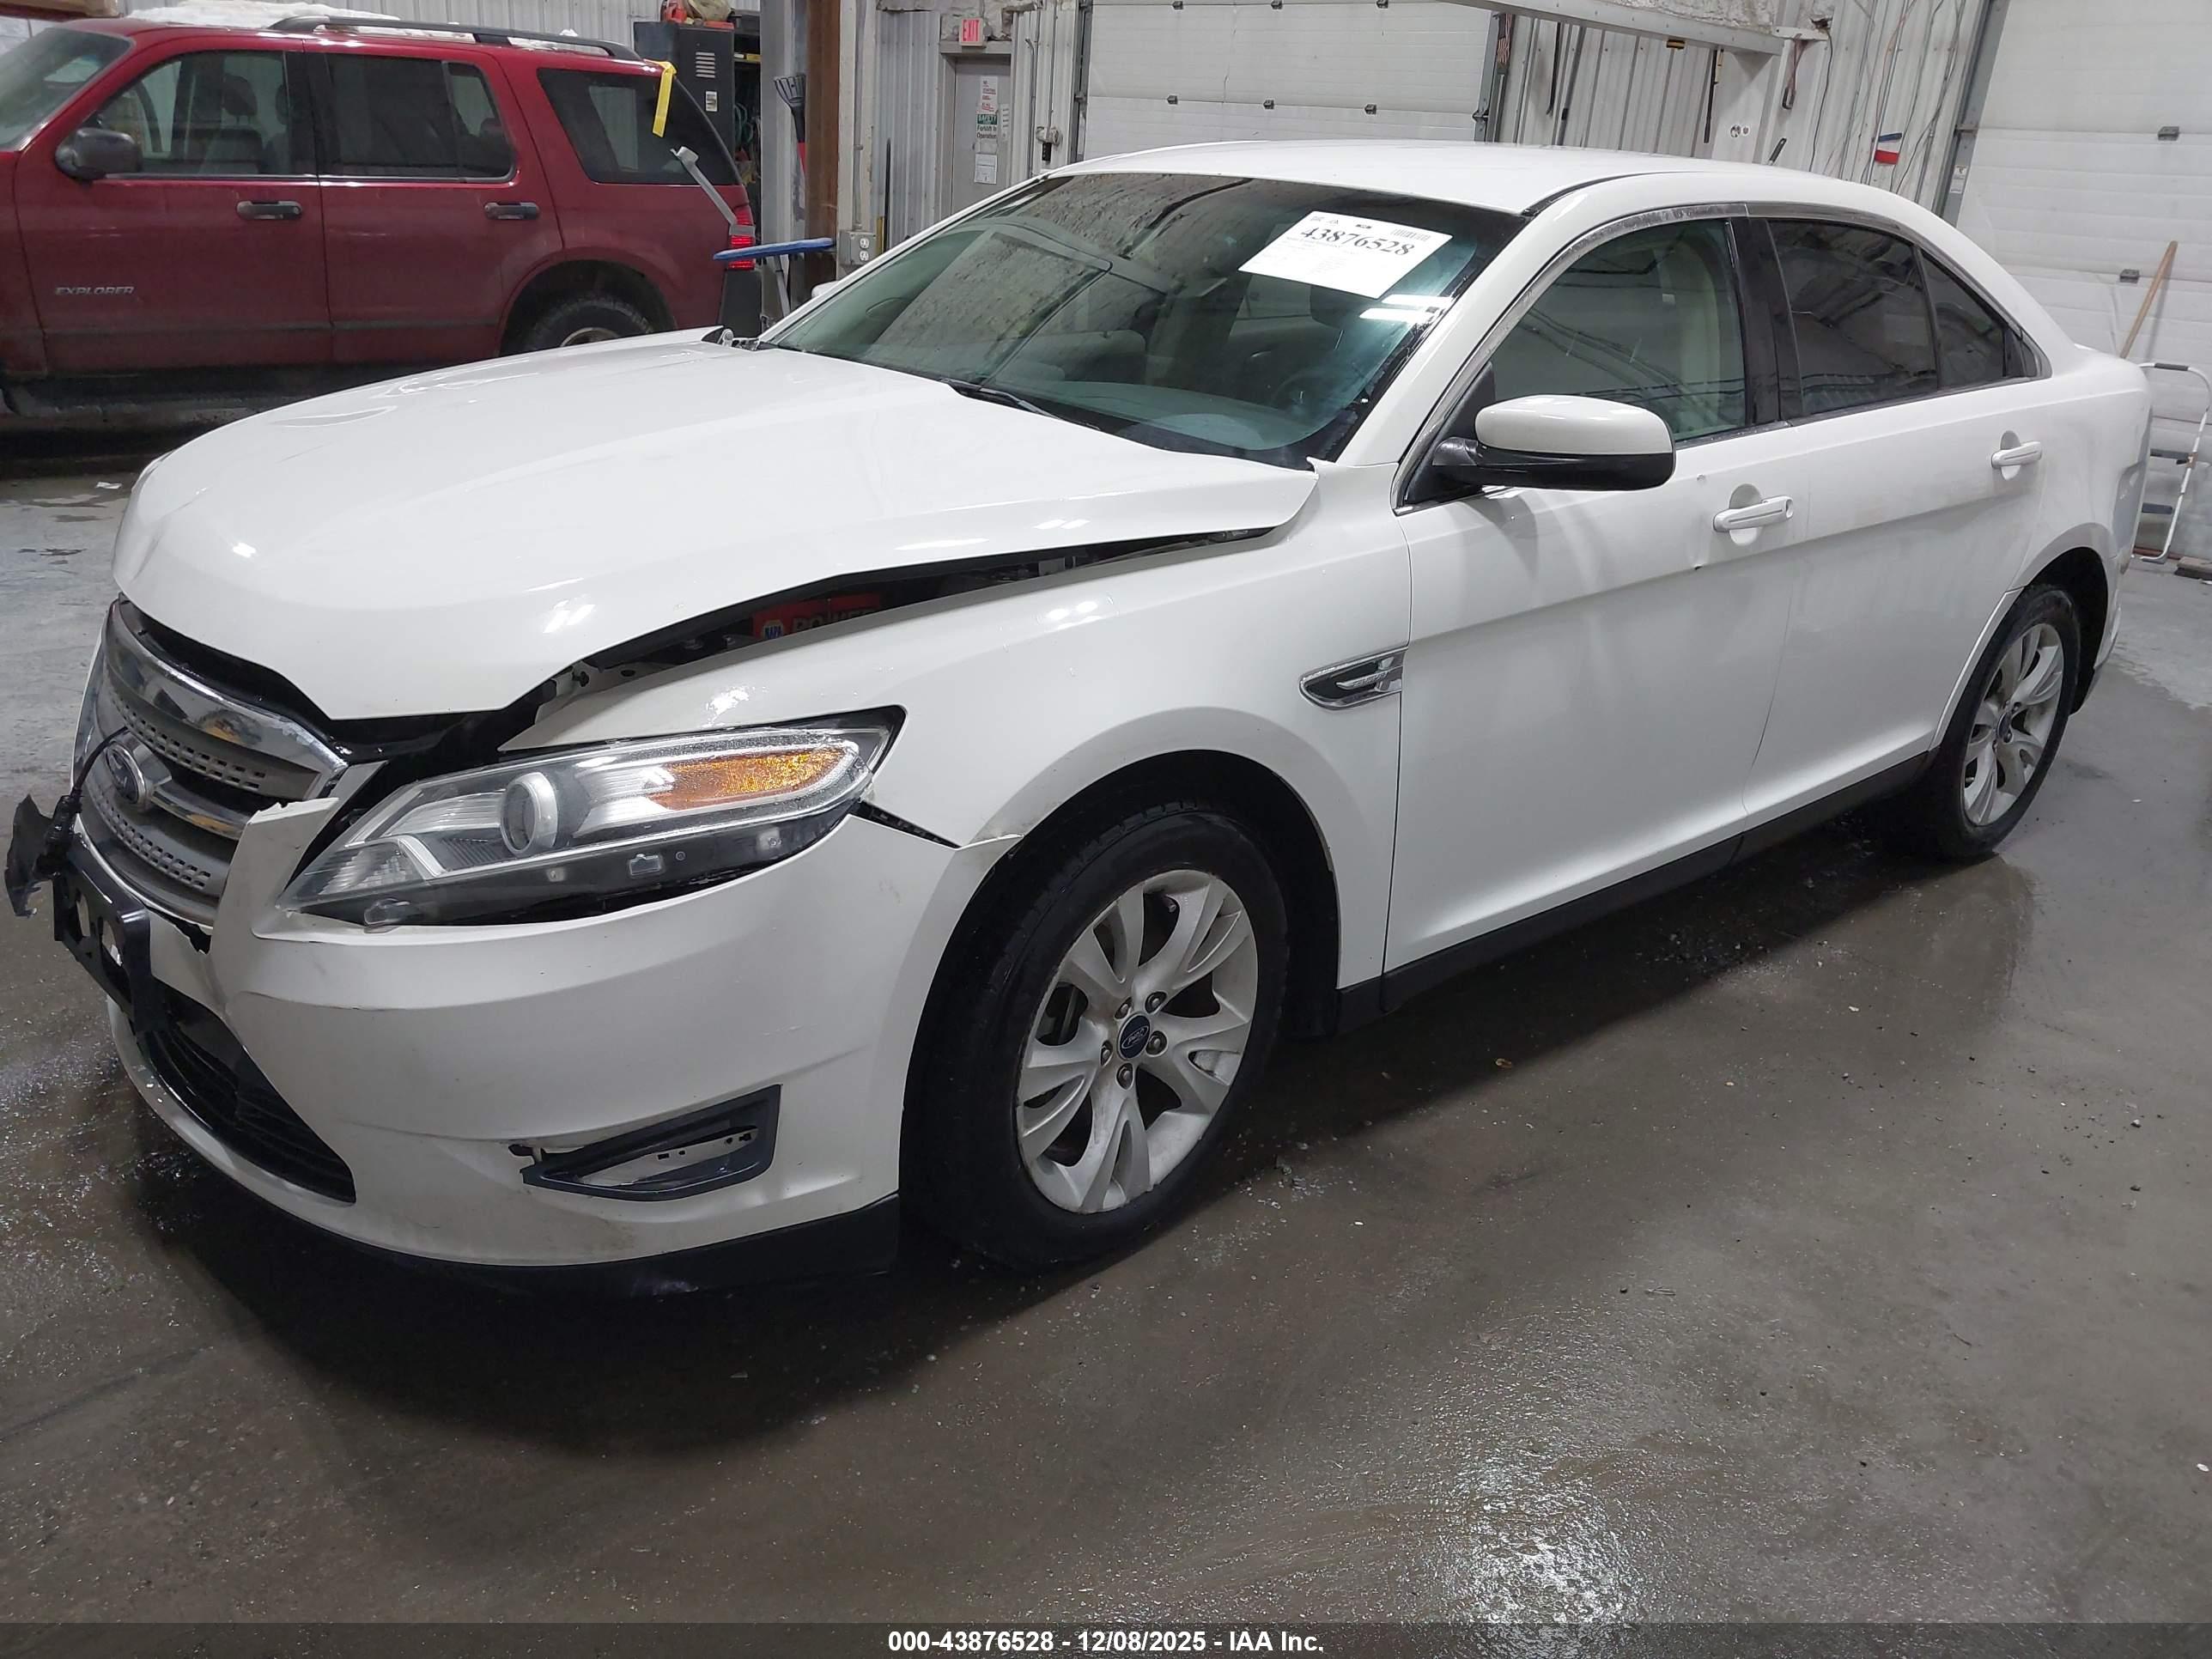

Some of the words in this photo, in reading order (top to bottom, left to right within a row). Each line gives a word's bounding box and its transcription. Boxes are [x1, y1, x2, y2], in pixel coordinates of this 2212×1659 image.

[962, 19, 979, 41] EXIT
[1300, 227, 1415, 256] 43876528
[56, 286, 135, 295] EXPLORER
